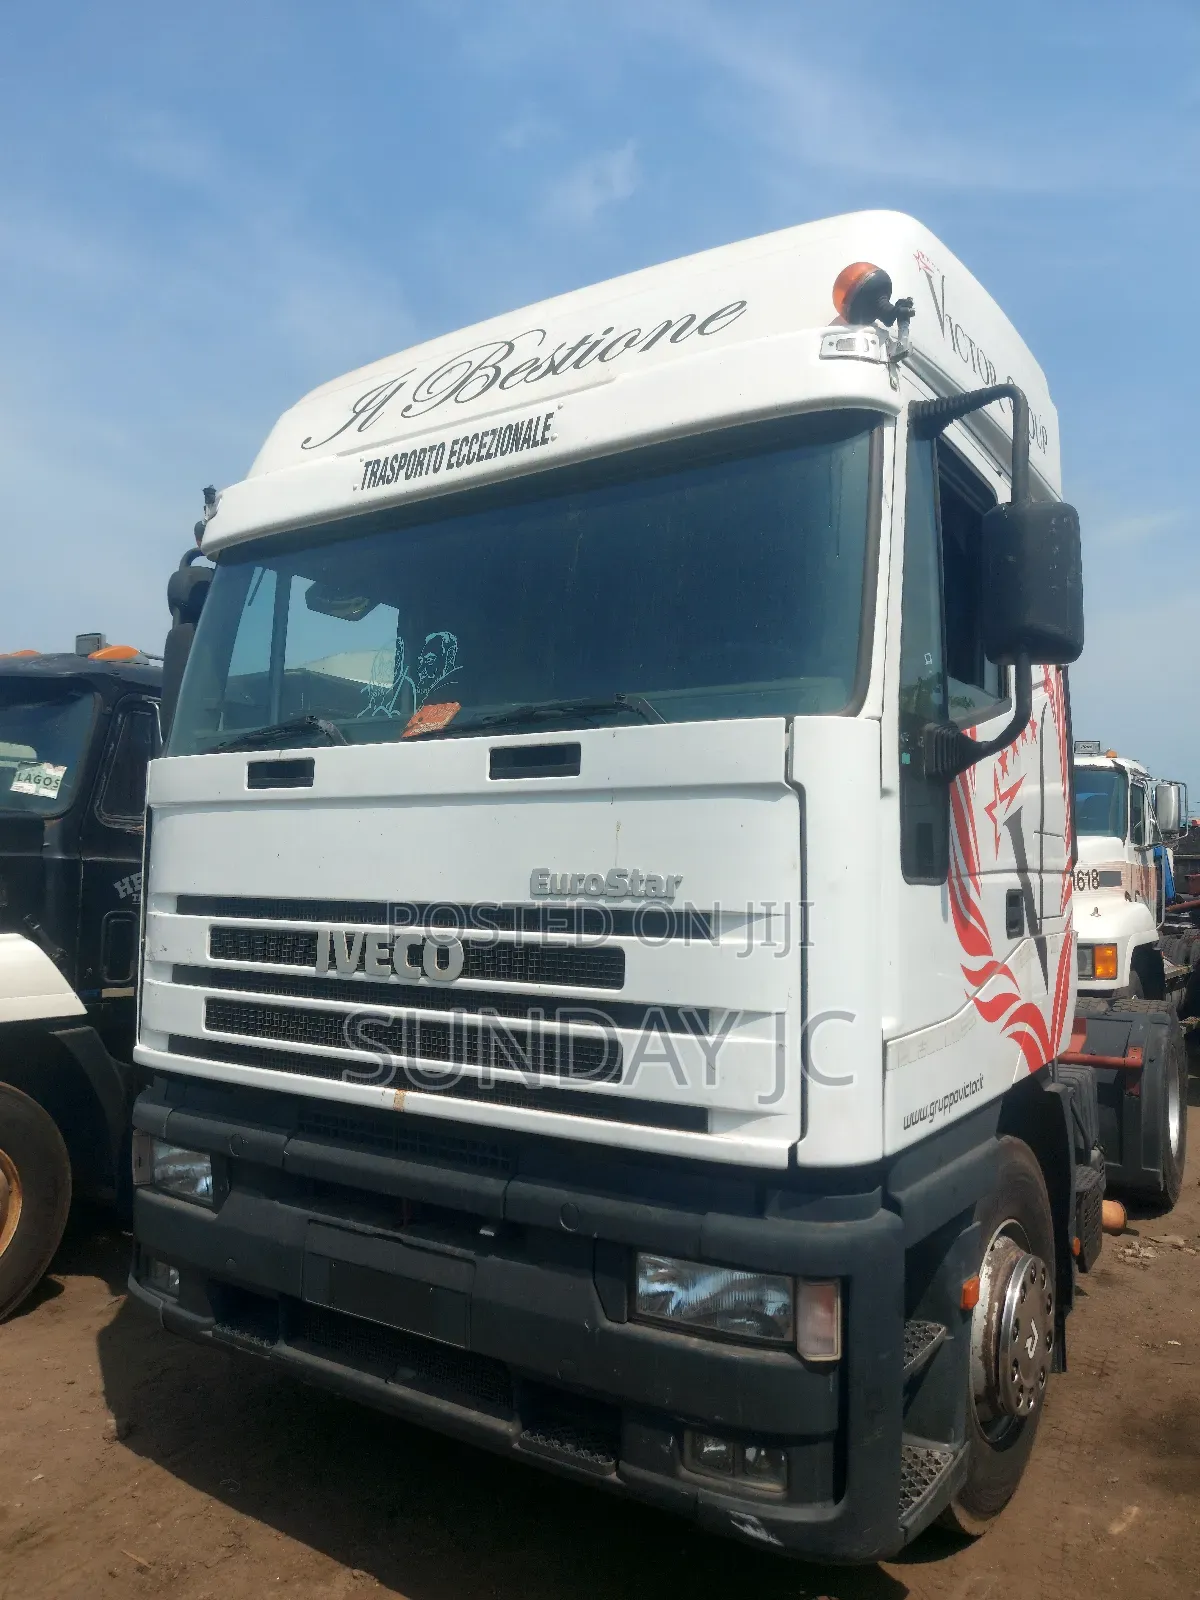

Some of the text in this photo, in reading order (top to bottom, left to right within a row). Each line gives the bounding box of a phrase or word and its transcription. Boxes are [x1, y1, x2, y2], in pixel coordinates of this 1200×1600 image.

[400, 299, 748, 418] Bestione
[360, 412, 555, 491] TRASPORTO ECCEZIONALE
[16, 772, 61, 789] LAGOS
[529, 868, 683, 900] EuroStar
[314, 929, 464, 981] IVECO
